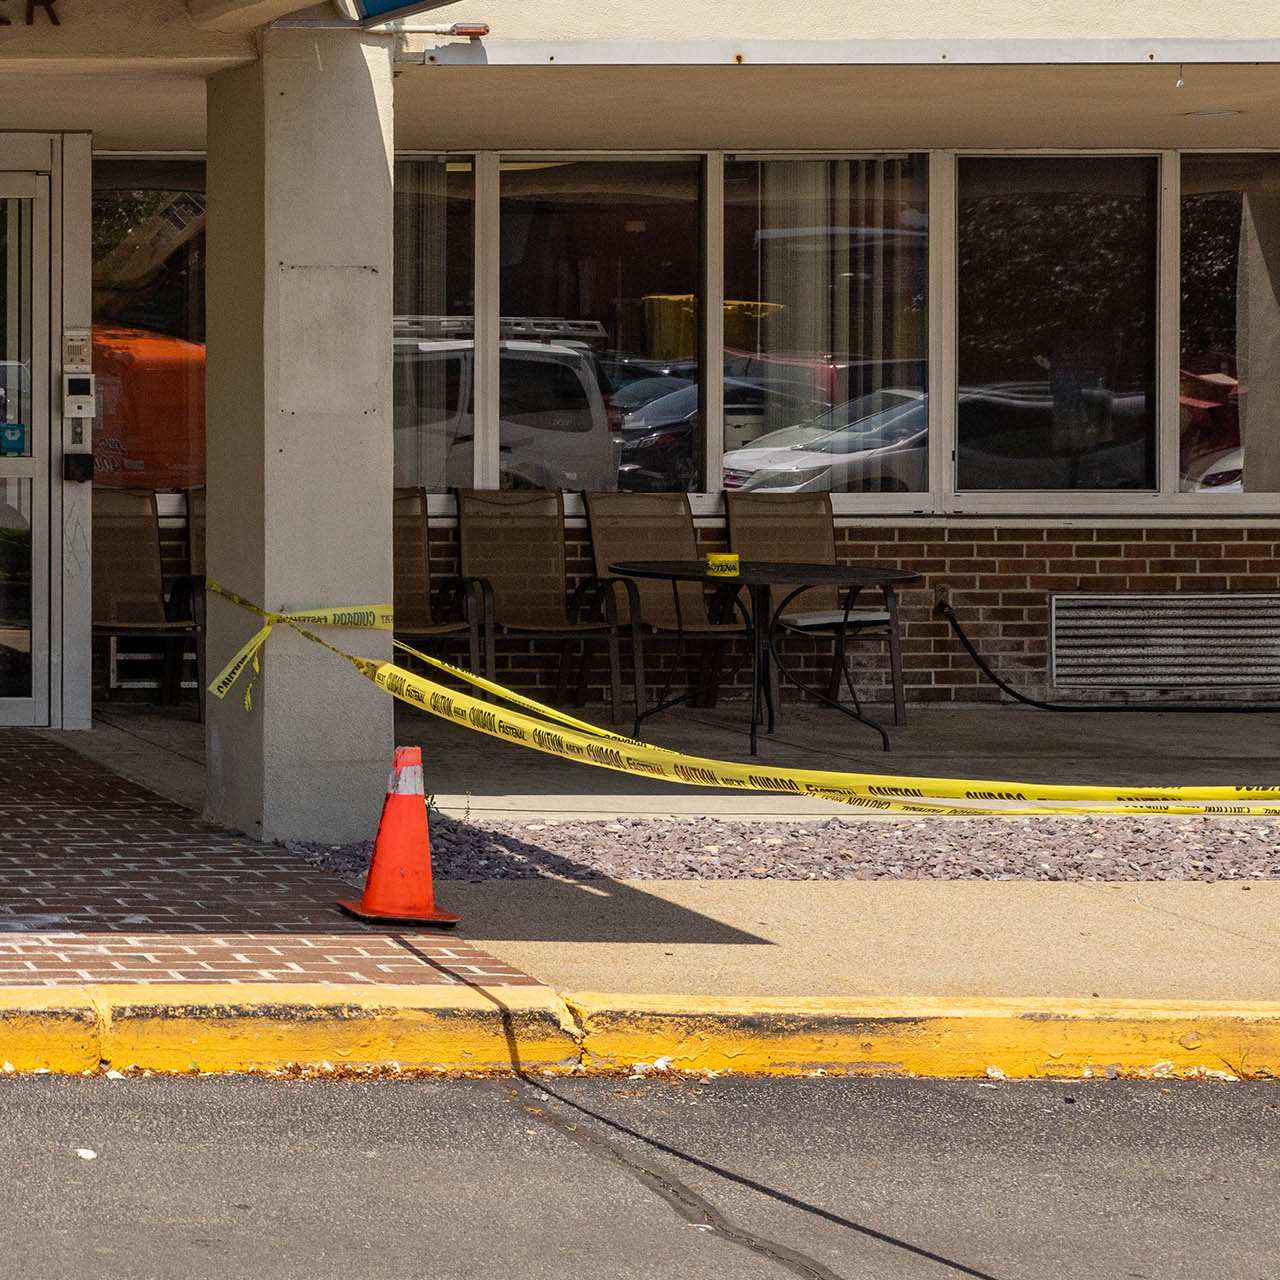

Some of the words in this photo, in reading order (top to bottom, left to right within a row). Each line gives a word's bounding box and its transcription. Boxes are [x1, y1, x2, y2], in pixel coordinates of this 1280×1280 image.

[498, 719, 528, 742] FASTENAL
[532, 727, 565, 755] CAUTION
[586, 743, 626, 771] CUIDADO
[626, 757, 669, 778] FASTENAL
[673, 763, 721, 786] CAUTION
[748, 774, 801, 792] CUIDADO
